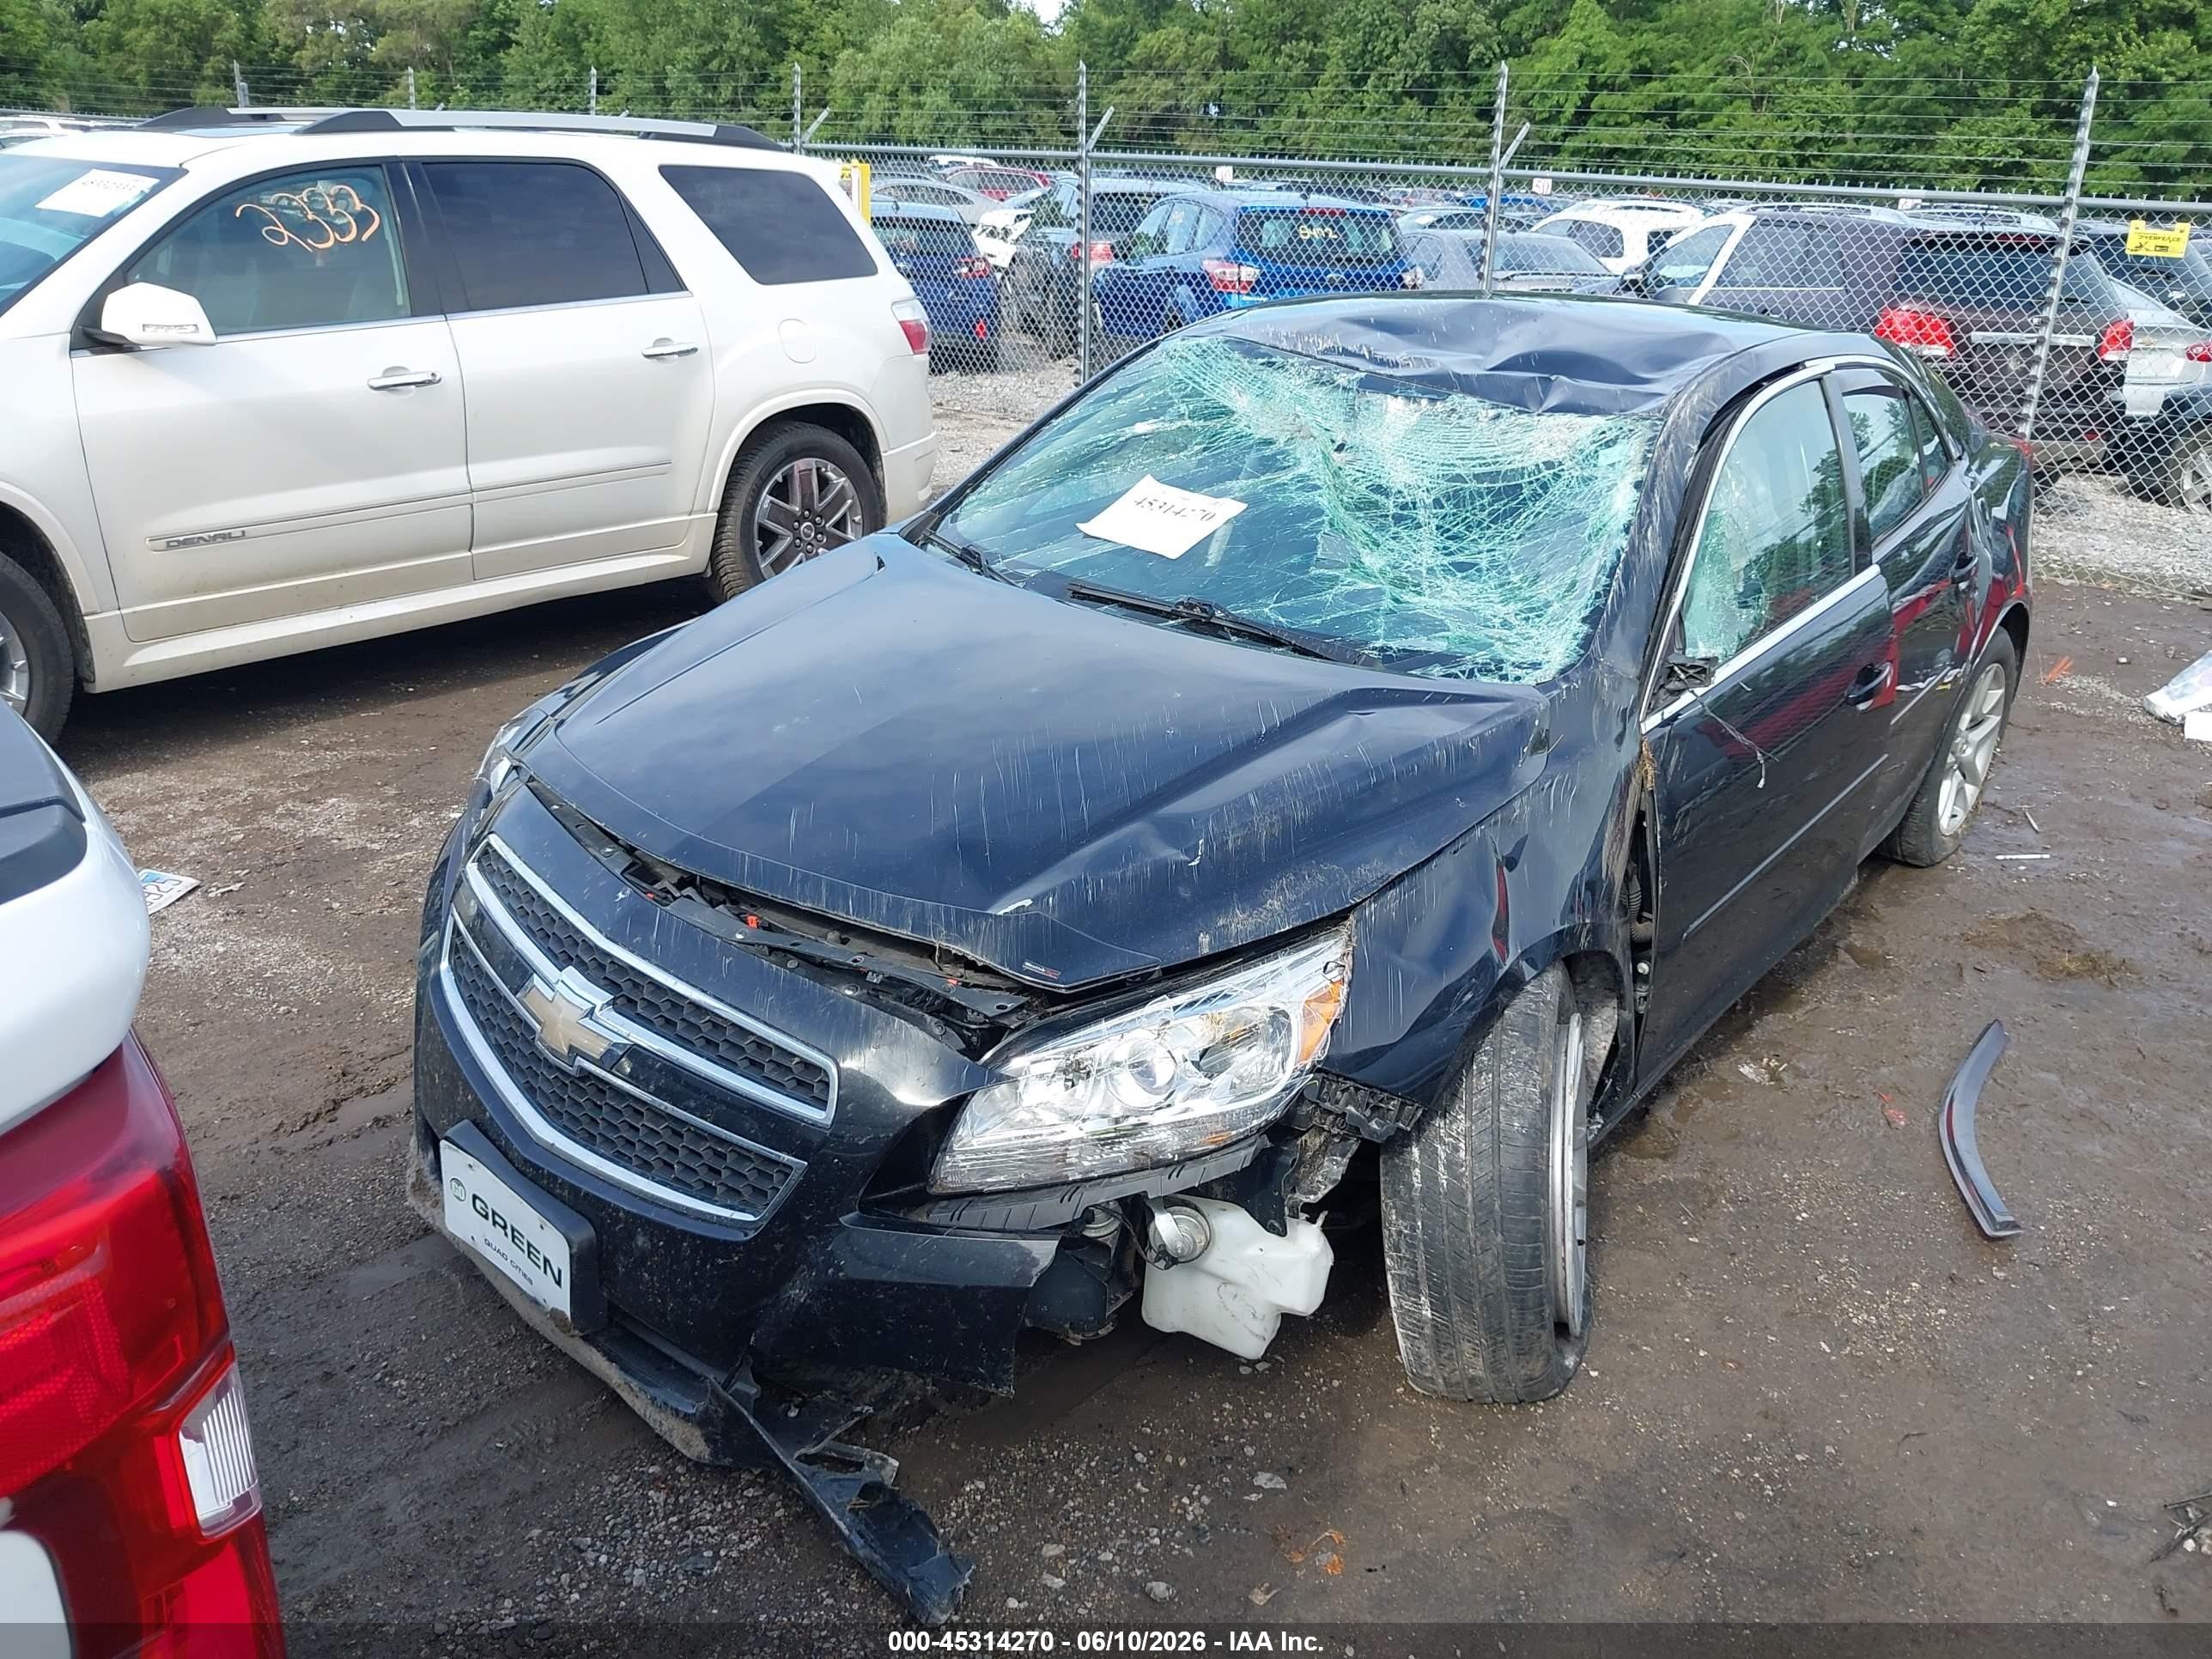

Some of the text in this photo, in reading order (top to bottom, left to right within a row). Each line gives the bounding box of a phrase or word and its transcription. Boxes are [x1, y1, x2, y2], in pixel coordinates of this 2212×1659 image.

[234, 184, 380, 252] 2333
[166, 530, 246, 549] DENALI
[471, 1193, 562, 1289] GREEN
[483, 1237, 533, 1286] QUAD CITIES
